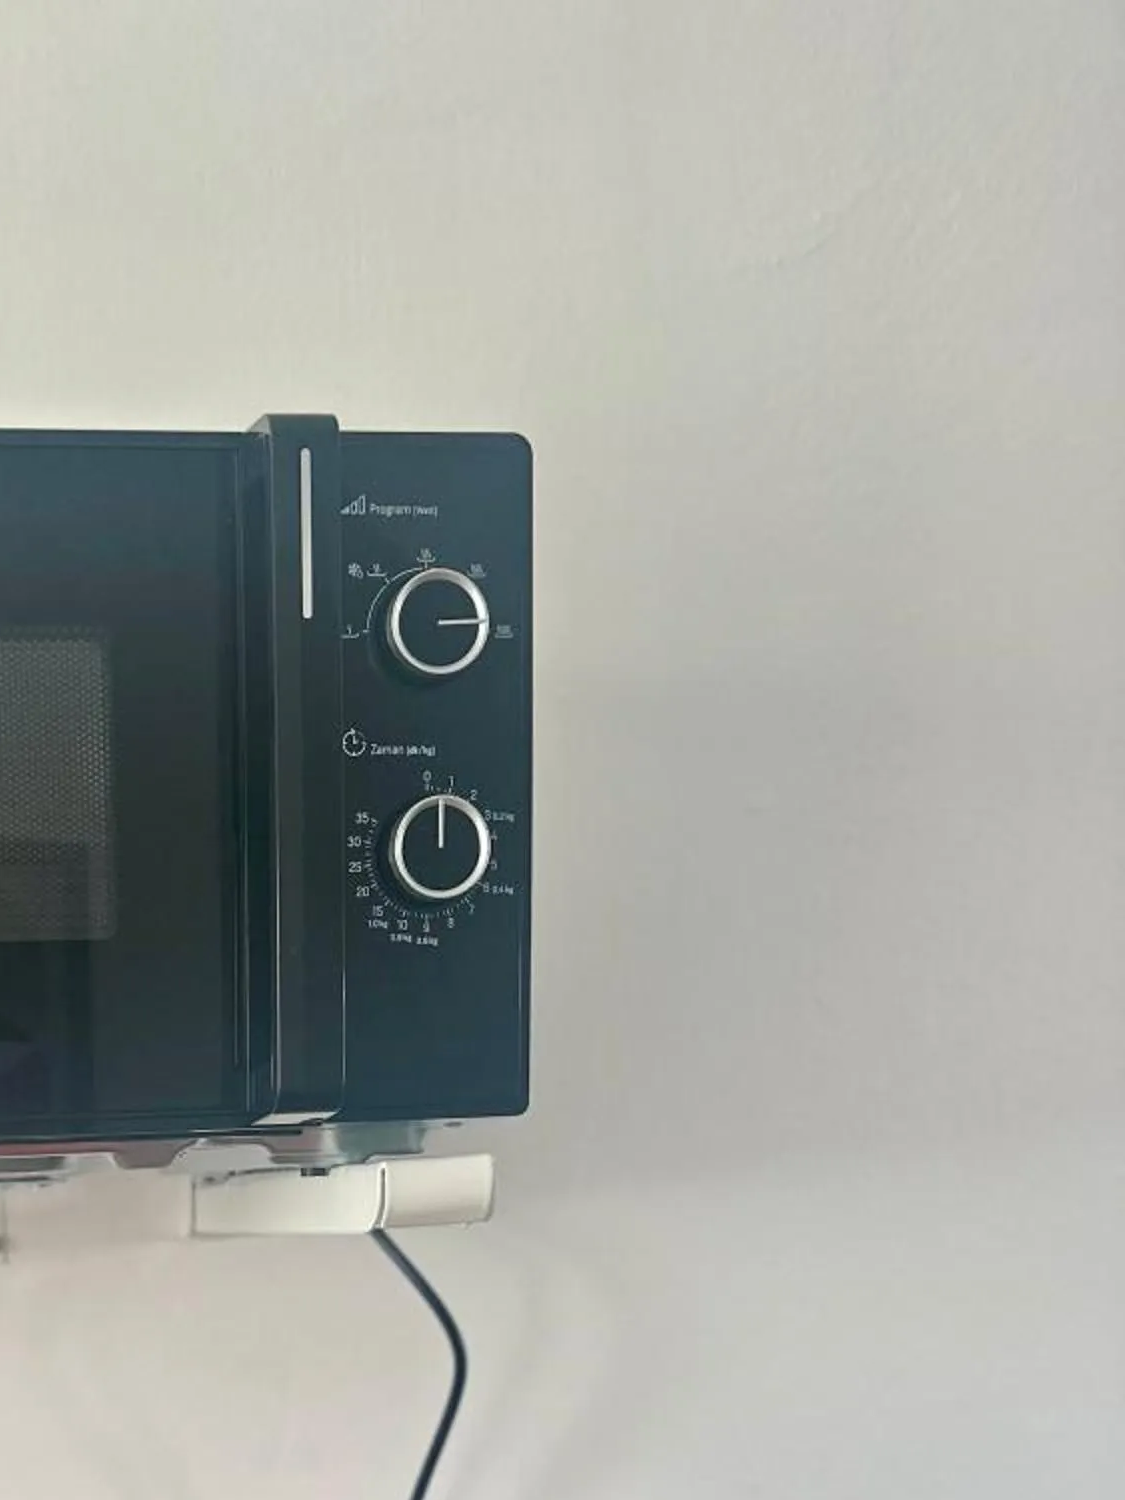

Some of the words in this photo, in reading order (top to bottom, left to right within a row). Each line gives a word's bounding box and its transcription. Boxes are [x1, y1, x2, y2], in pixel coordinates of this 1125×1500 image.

[370, 503, 412, 518] Program
[370, 743, 404, 756] Zaman
[422, 770, 432, 781] 0
[448, 775, 454, 788] 1
[470, 789, 478, 801] 2
[355, 811, 370, 825] 35
[347, 835, 362, 848] 30
[348, 861, 362, 873] 25
[356, 885, 370, 897] 20
[372, 904, 384, 917] 15
[396, 919, 408, 931] 10
